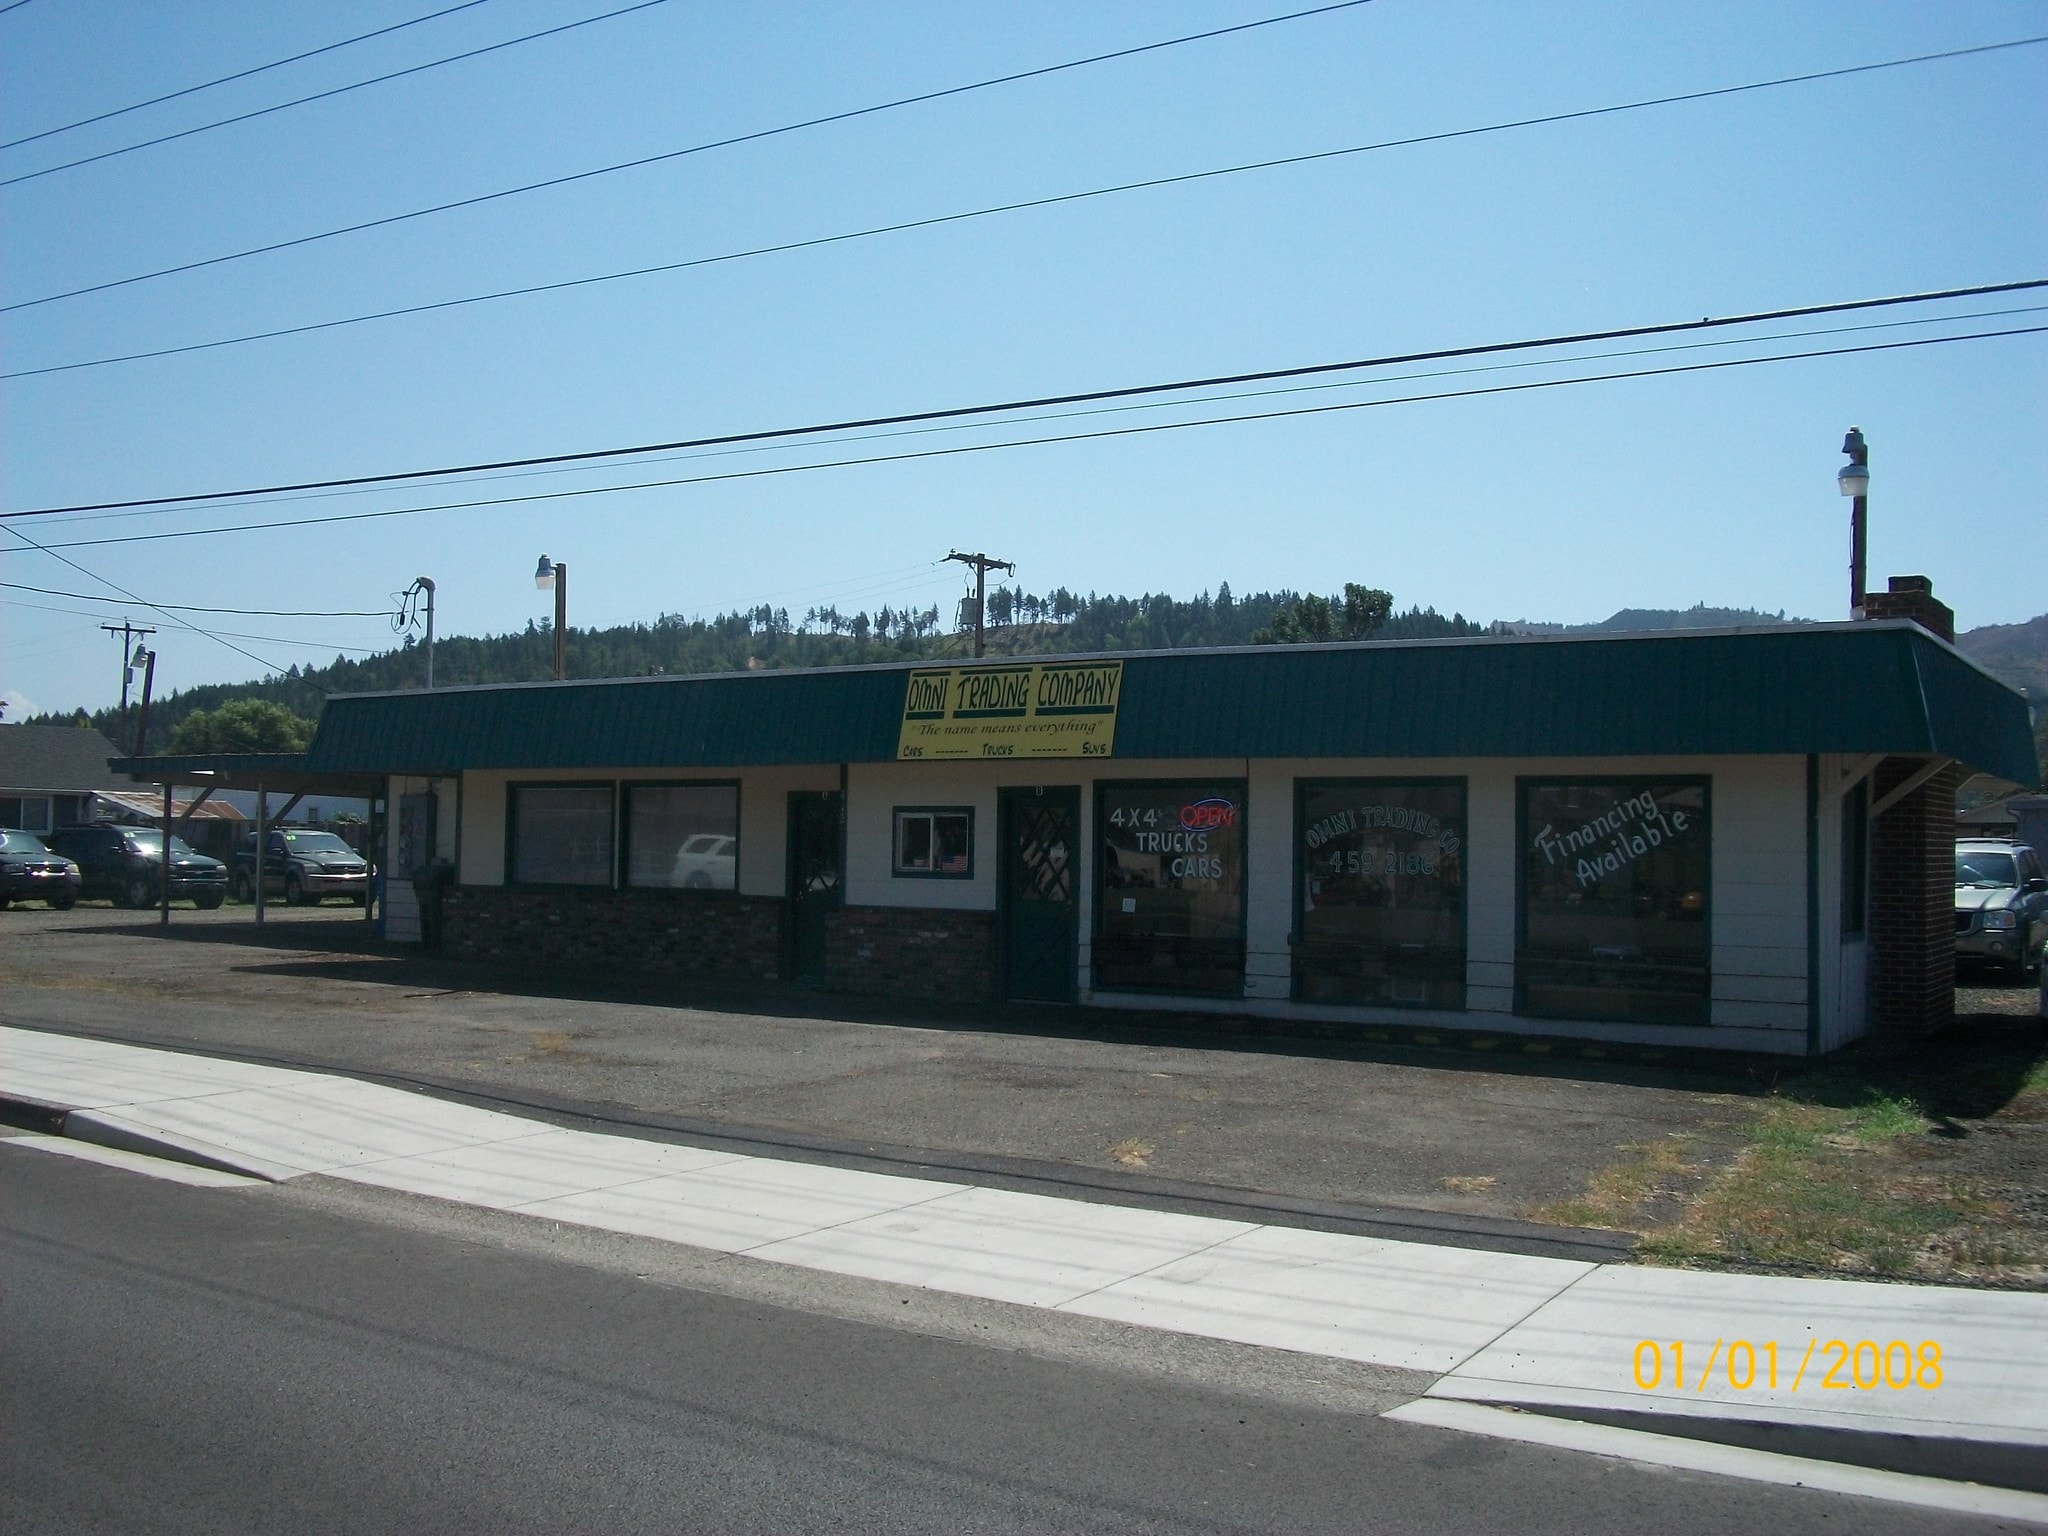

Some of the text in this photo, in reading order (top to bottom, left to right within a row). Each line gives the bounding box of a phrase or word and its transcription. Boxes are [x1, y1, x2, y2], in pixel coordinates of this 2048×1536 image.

[908, 669, 1120, 711] OMNI TRADING COMPANY
[944, 725, 976, 736] name
[981, 723, 1021, 734] means
[1179, 804, 1234, 827] OPEN
[1305, 810, 1358, 849] OMNI
[1361, 805, 1440, 838] TRADING
[1534, 789, 1660, 865] Financing
[1135, 831, 1208, 853] TRUCKS
[1575, 810, 1690, 887] Available
[1171, 857, 1223, 879] CARS
